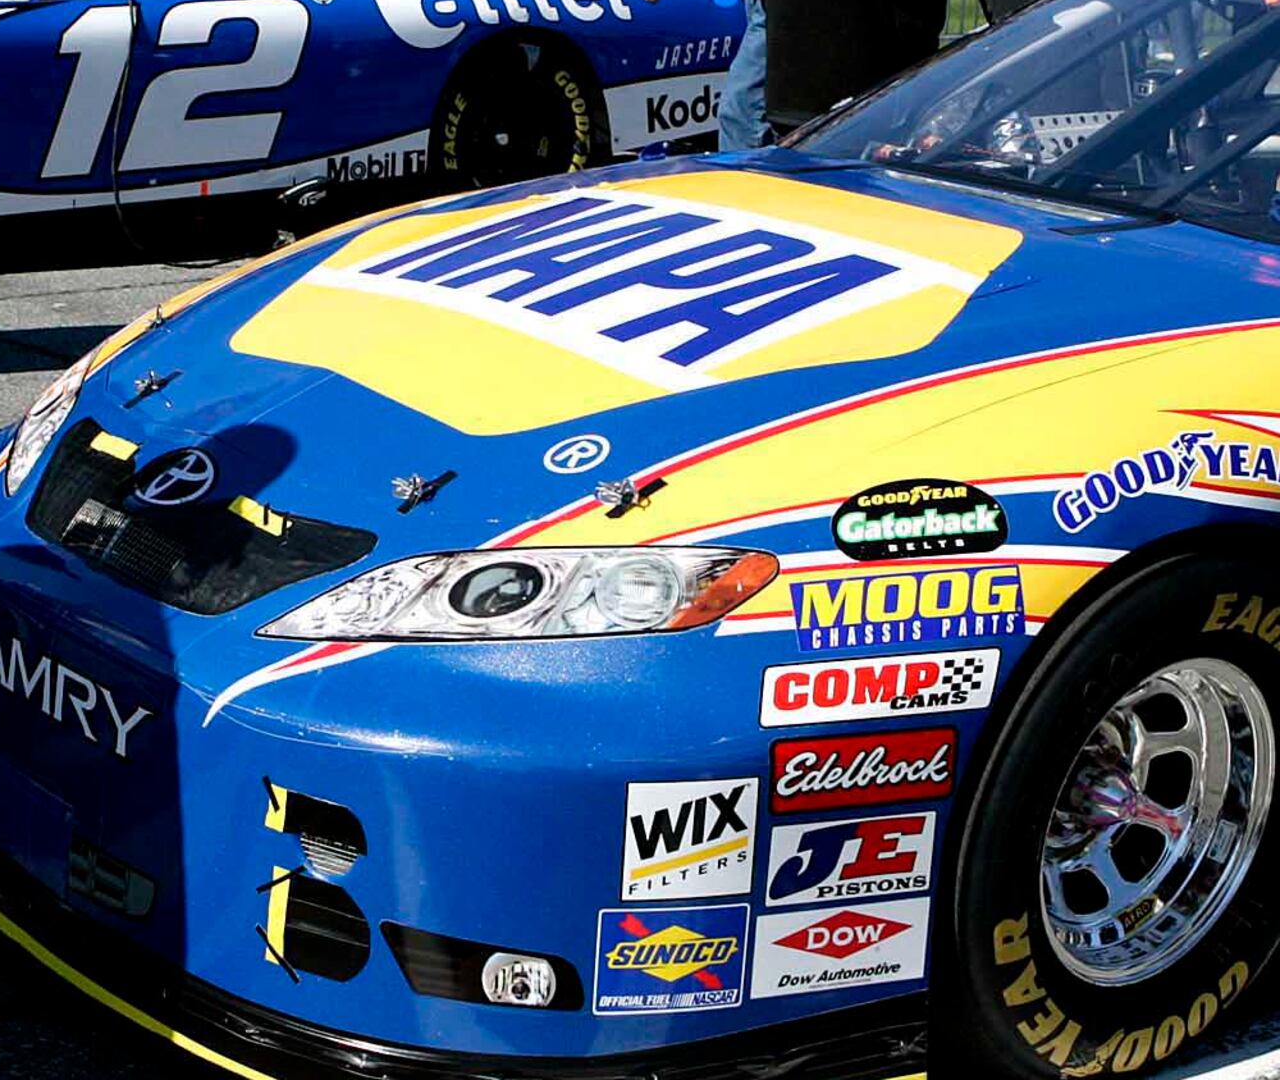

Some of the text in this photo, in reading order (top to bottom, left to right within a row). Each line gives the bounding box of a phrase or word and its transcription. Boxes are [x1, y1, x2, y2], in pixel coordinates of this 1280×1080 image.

[655, 35, 734, 70] JASPER
[646, 85, 721, 134] Kod
[444, 92, 469, 170] EAGLE
[326, 148, 397, 184] Mobil
[358, 195, 902, 367] NAPA
[857, 485, 968, 508] GOODYEAR
[836, 503, 1001, 543] Gatorback
[886, 537, 966, 552] BELTS
[799, 566, 1020, 629] MOOG
[811, 612, 1017, 650] CHASSIS PARTS
[772, 660, 940, 711] COMP
[889, 689, 970, 712] CAMS
[776, 742, 950, 798] Edelbrock
[630, 784, 748, 860] WIX
[628, 850, 748, 896] FILTERS
[768, 815, 927, 901] JE
[815, 874, 928, 900] PISTONS
[611, 938, 734, 968] SUNOCO
[805, 920, 887, 951] DOW
[777, 960, 902, 989] Dow Automotive
[598, 988, 738, 1008] OFFICIAL FUEL NASCAR
[994, 911, 1250, 1079] GOODYEAR
